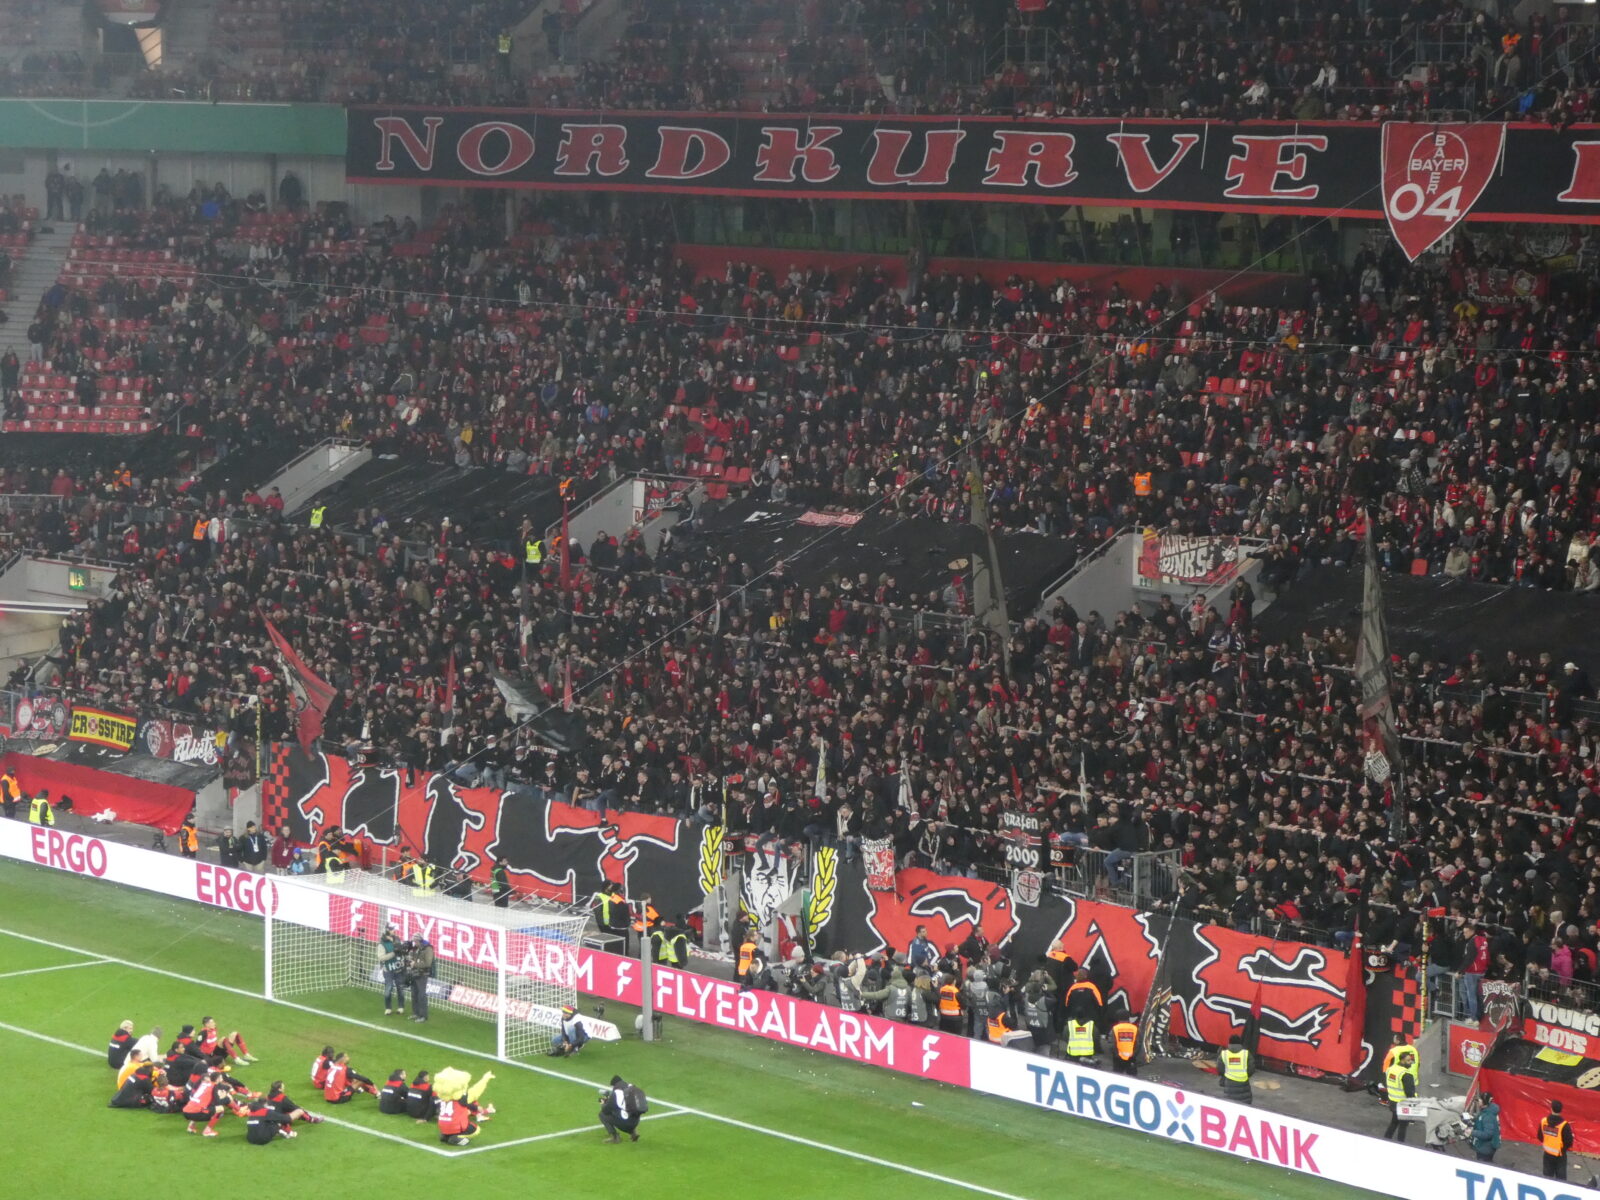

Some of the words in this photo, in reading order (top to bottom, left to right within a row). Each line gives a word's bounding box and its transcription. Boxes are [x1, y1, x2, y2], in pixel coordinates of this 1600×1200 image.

[373, 115, 1330, 200] NORDKURVE
[1409, 158, 1466, 172] BAYER
[1005, 845, 1040, 868] 2009
[31, 826, 108, 877] ERGO
[195, 862, 279, 917] ERGO
[656, 970, 895, 1065] FLYERALARM
[1527, 999, 1600, 1037] YOUNG
[1534, 1023, 1588, 1055] BOYS
